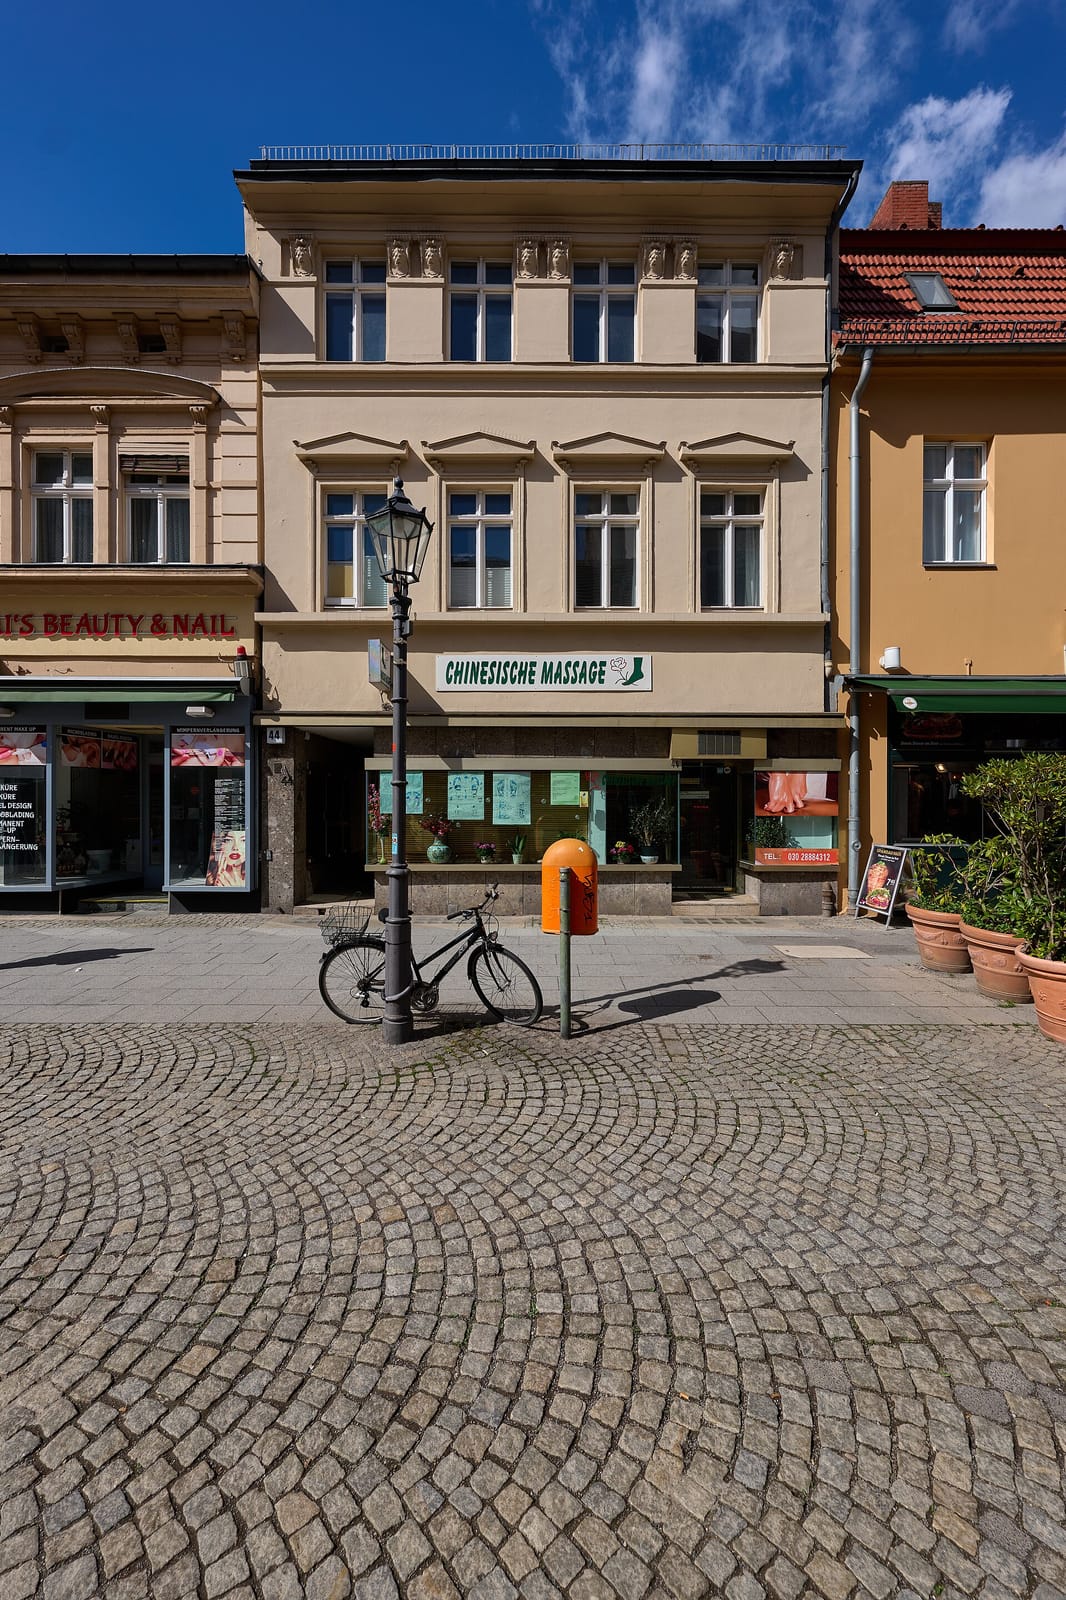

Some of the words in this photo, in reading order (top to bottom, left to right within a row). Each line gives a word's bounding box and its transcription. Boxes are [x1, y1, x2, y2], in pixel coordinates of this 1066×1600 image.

[0, 614, 34, 637] I'S
[43, 613, 144, 637] BEAUTY
[150, 613, 168, 637] &
[173, 613, 235, 637] NAIL
[445, 660, 538, 685] CHINESISCHE
[540, 660, 607, 685] MASSAGE
[269, 730, 280, 740] 44
[0, 811, 35, 819] OBLADING
[787, 853, 800, 861] 030
